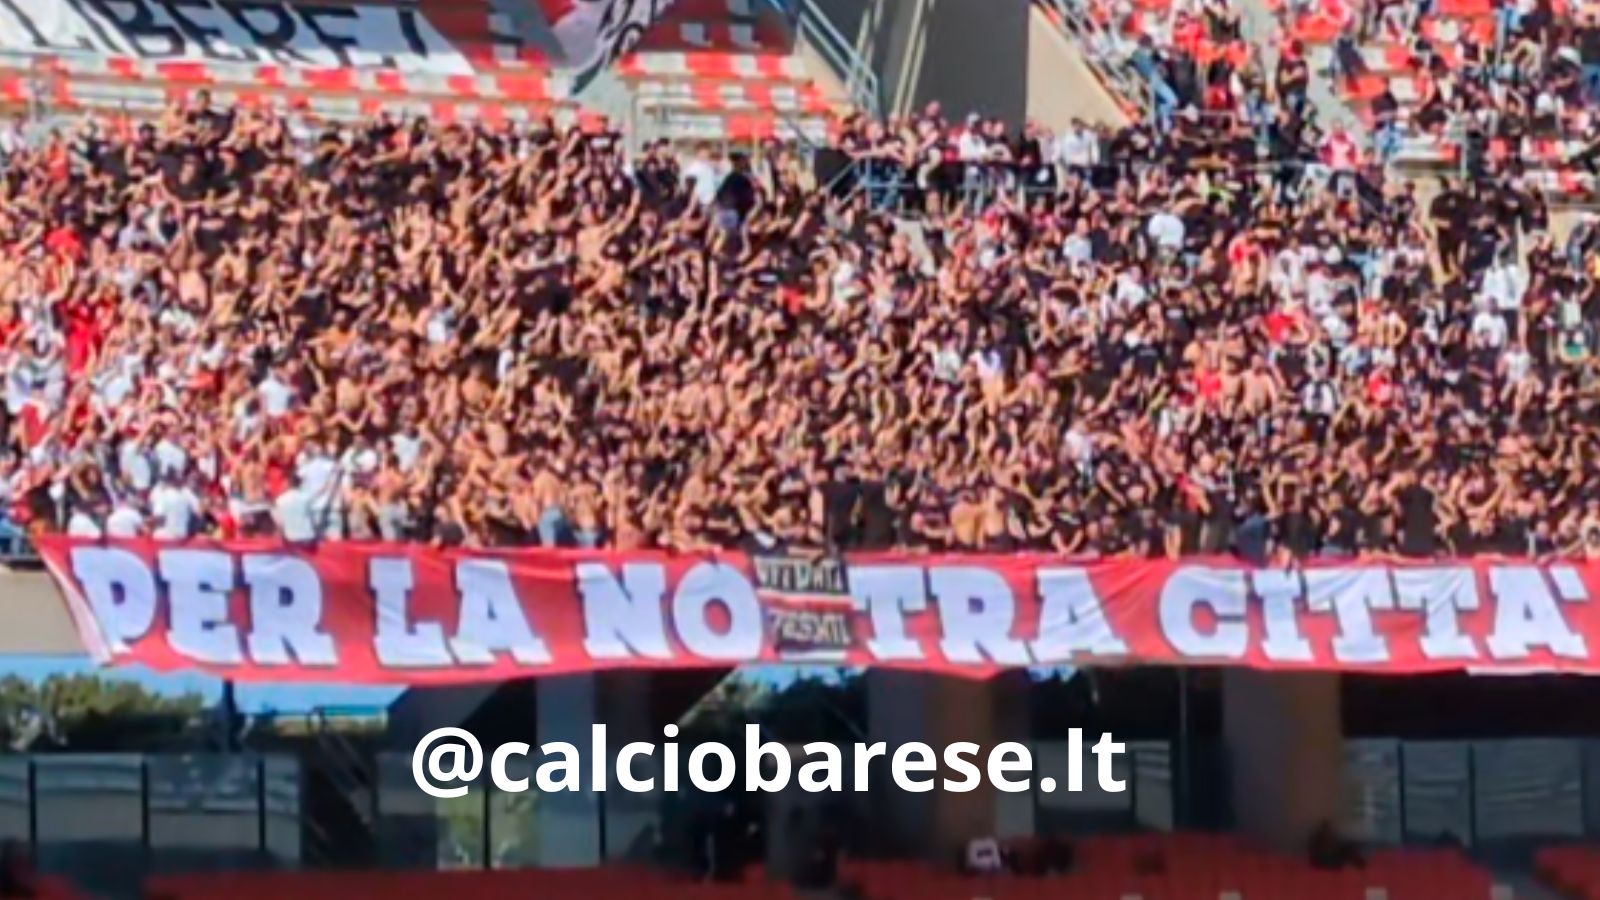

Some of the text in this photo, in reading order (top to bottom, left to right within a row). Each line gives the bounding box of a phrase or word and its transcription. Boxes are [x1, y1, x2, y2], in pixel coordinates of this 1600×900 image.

[69, 545, 339, 665] PER
[369, 557, 553, 665] LA
[576, 560, 1130, 664] NOTRA
